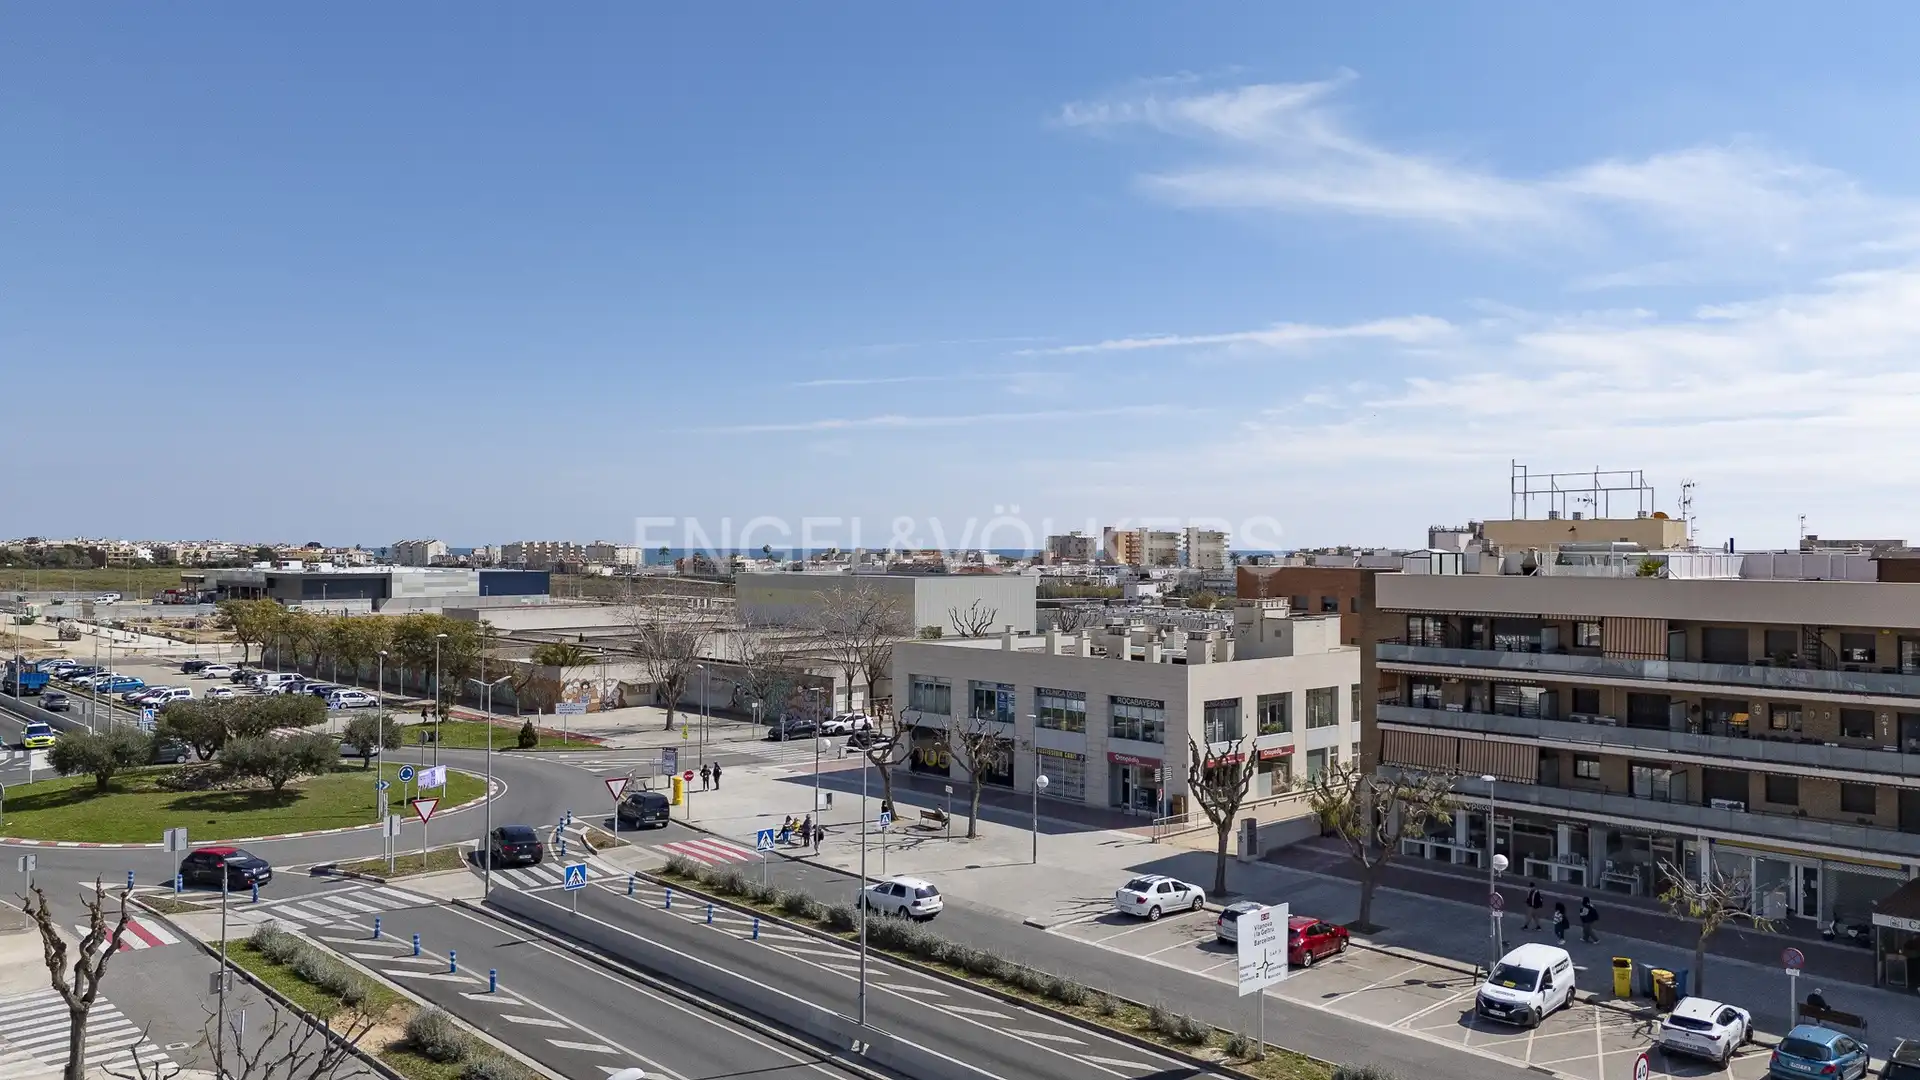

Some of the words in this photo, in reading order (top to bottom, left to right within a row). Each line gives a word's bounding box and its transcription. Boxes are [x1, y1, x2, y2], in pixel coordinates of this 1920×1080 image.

[1117, 696, 1160, 708] ROCABAYERA
[1254, 935, 1276, 946] Barcelona
[1638, 1064, 1646, 1079] 40
